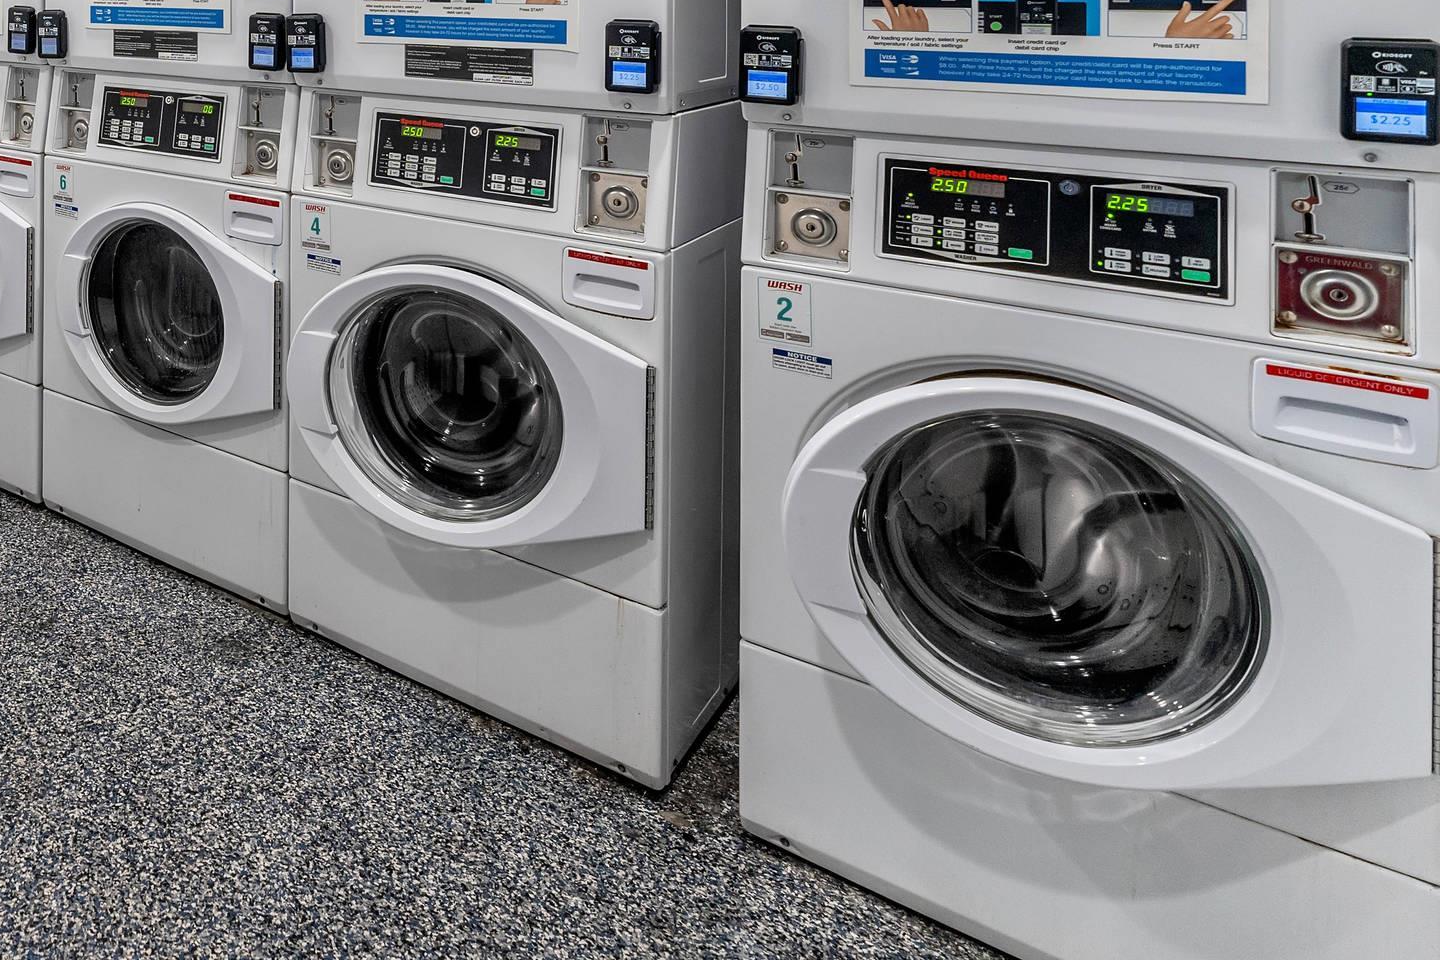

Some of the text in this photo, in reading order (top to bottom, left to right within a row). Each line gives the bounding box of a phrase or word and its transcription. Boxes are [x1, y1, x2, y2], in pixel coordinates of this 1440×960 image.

[619, 73, 641, 82] $2.25
[400, 118, 421, 126] Speed
[1370, 114, 1412, 127] $2.25
[402, 126, 423, 137] 2.50
[496, 135, 518, 148] 2.25
[928, 166, 1009, 182] Speed Queen
[59, 174, 67, 190] 6
[931, 178, 968, 193] 2.50
[305, 204, 326, 212] WASH
[1107, 195, 1149, 212] 2.25
[310, 216, 321, 236] 4
[953, 253, 977, 261] WASHER
[1305, 254, 1373, 271] GREENWALD
[767, 280, 803, 292] WASH
[776, 296, 793, 322] 2
[786, 351, 818, 362] NOTICE
[1277, 367, 1313, 380] LIQUID
[1383, 383, 1414, 396] ONLY
